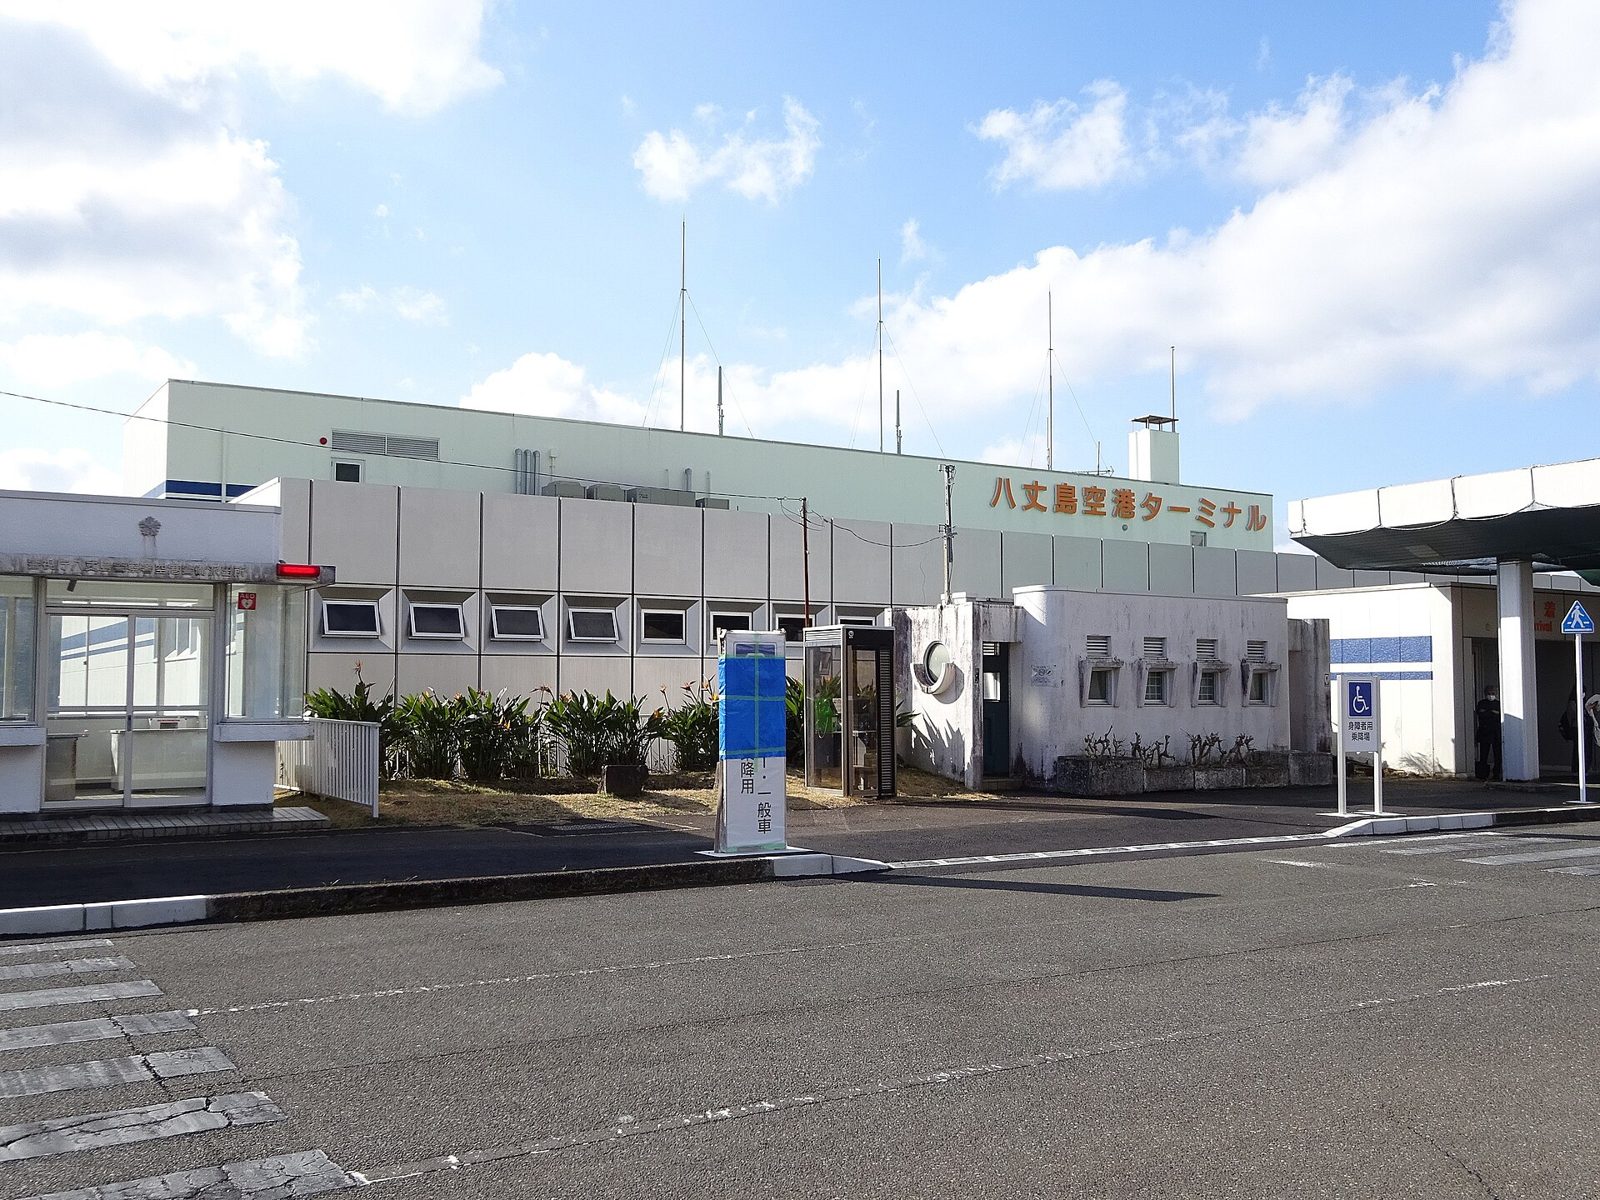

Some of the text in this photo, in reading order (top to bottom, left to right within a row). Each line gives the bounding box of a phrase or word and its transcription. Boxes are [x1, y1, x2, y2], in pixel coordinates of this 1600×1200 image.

[989, 477, 1267, 532] 八丈島空港ターミナル
[1534, 621, 1552, 632] rrival
[1348, 721, 1373, 731] 身障者用
[1351, 732, 1371, 742] 乗降場
